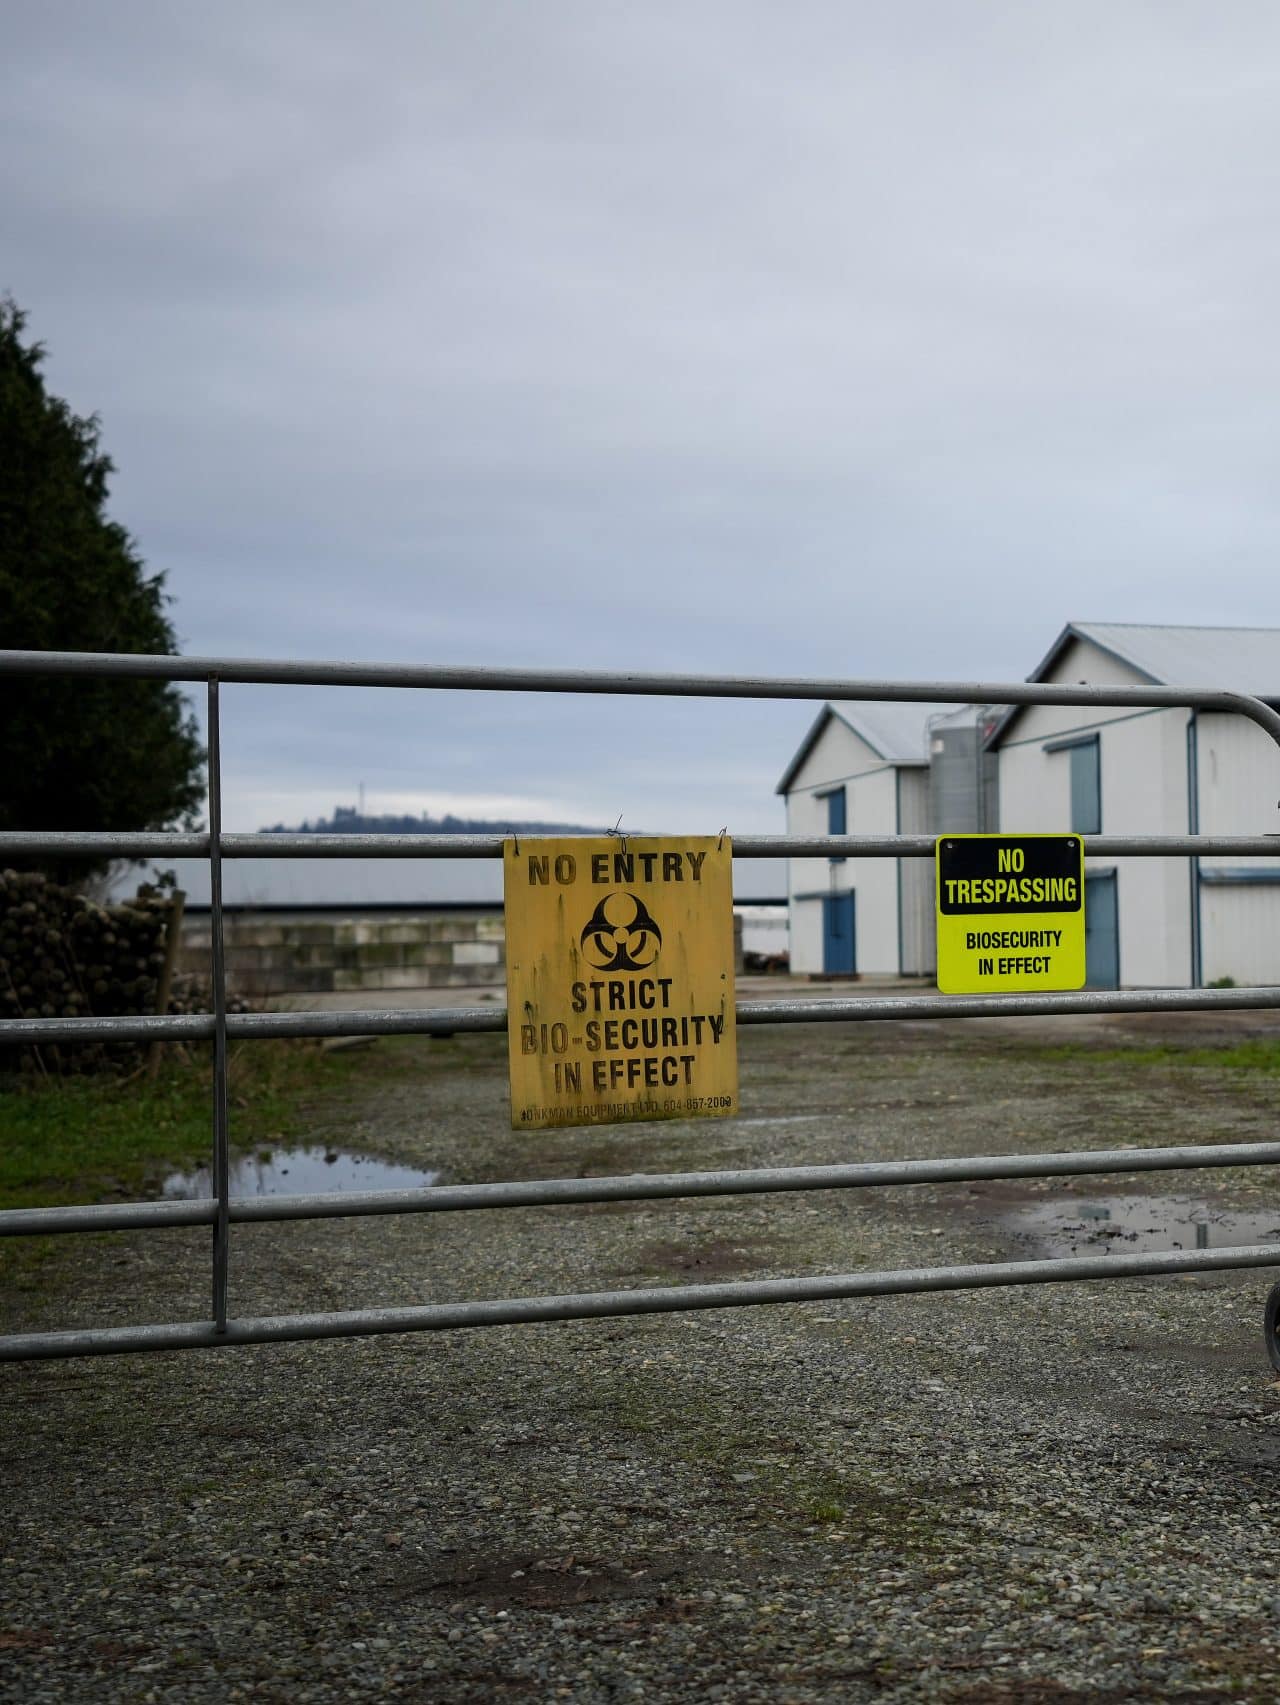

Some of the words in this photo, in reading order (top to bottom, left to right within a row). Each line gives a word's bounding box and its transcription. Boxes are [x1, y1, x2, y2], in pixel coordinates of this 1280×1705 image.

[528, 854, 576, 886] NO
[592, 851, 706, 884] ENTRY
[998, 848, 1025, 873] NO
[945, 877, 1077, 904] TRESPASSING
[966, 930, 1062, 950] BIOSECURITY
[978, 958, 994, 975] IN
[998, 956, 1051, 975] EFFECT
[572, 978, 672, 1013] STRICT
[521, 1015, 724, 1055] BIO-SECURITY
[554, 1061, 581, 1093] IN
[593, 1055, 695, 1091] EFFECT
